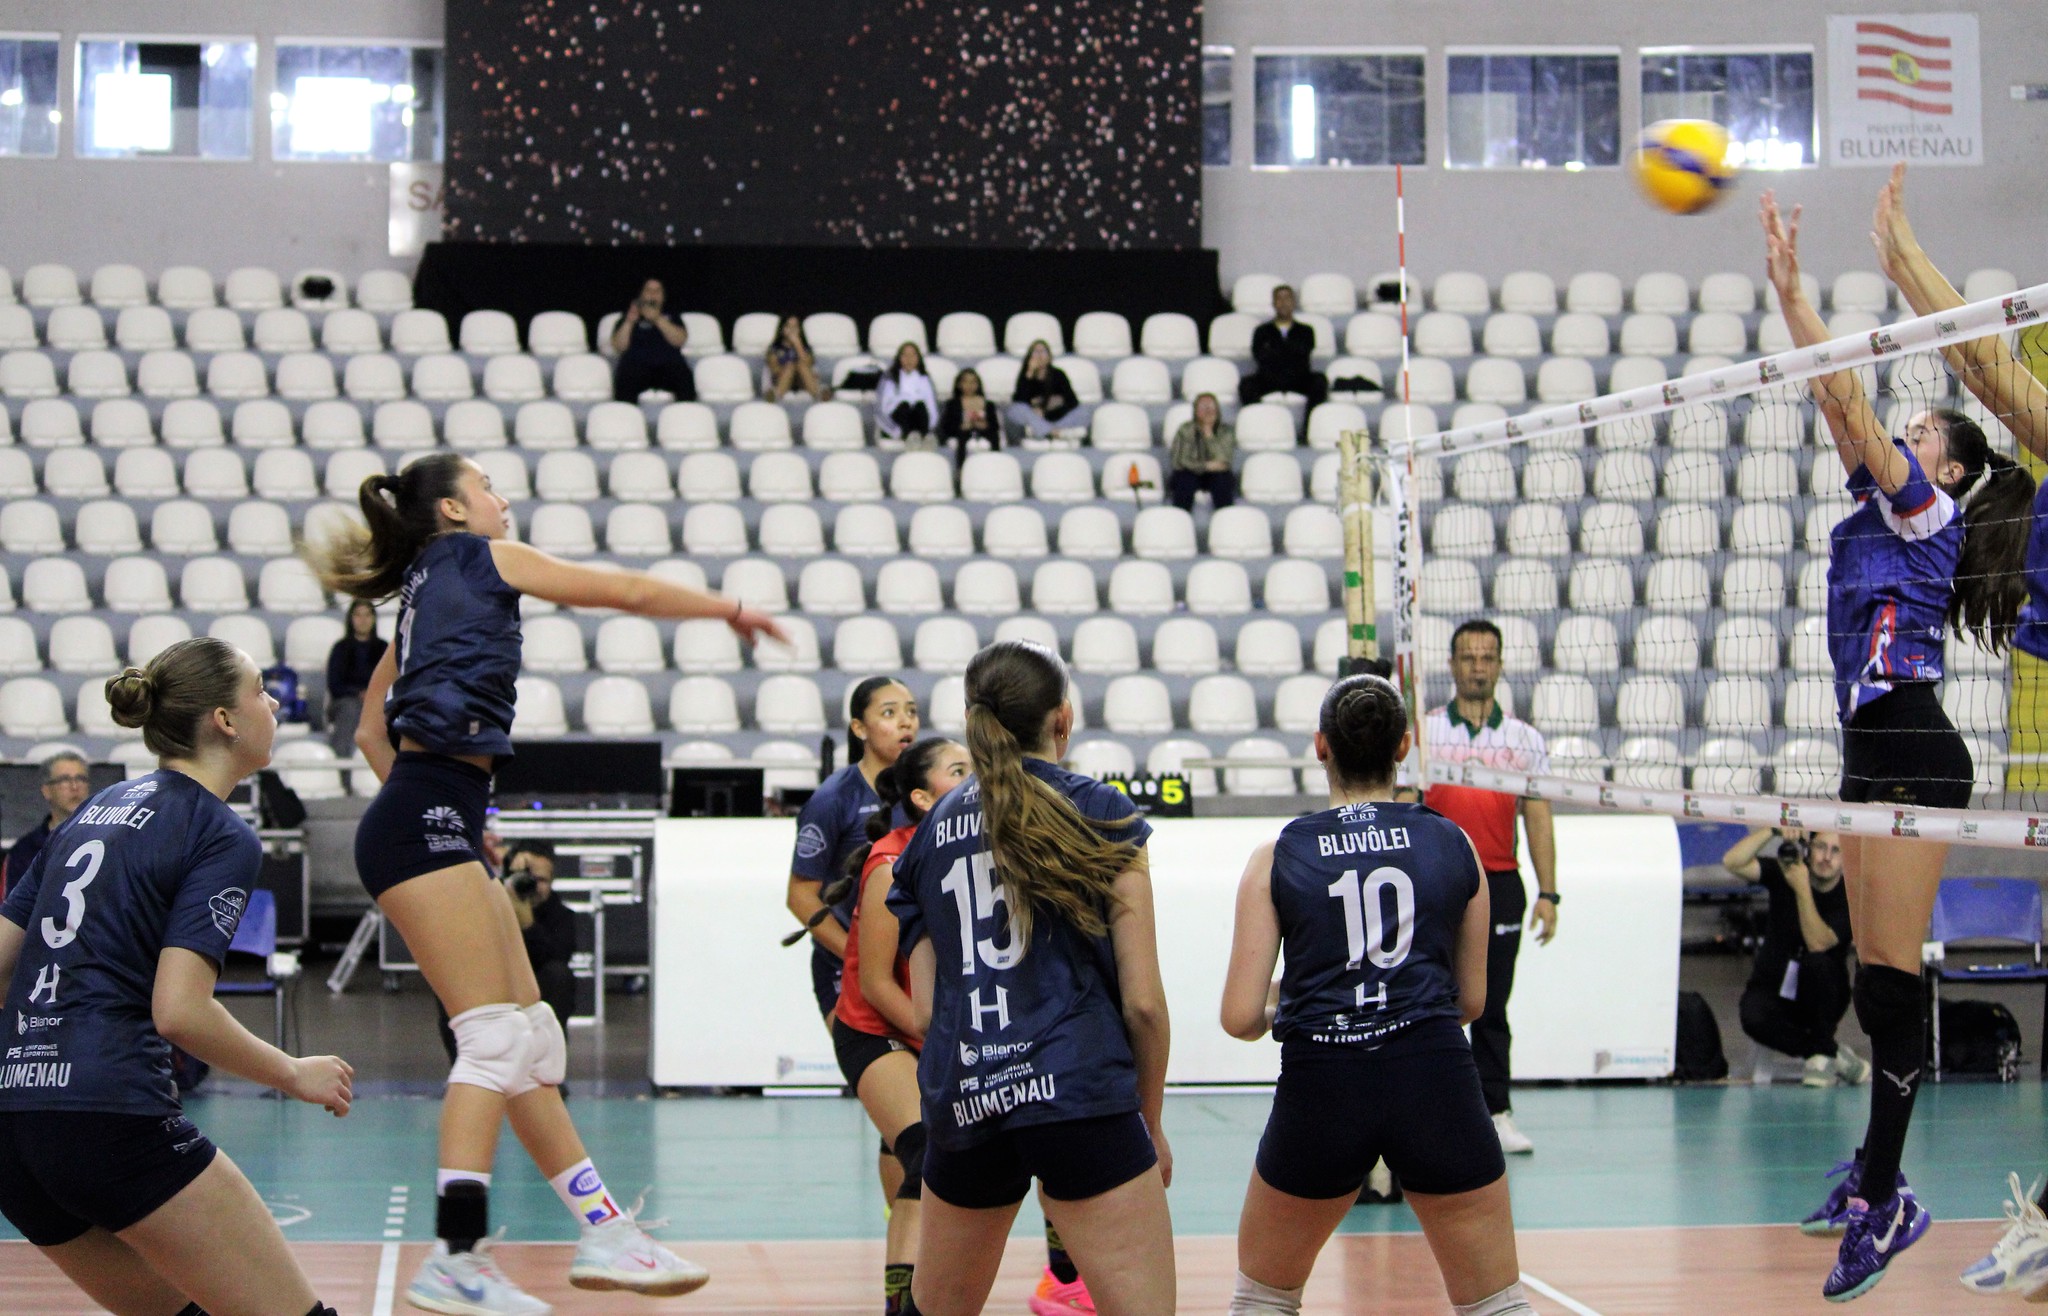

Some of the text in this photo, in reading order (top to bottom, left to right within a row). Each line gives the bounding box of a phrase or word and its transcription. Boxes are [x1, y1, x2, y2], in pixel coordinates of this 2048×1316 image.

[1867, 123, 1944, 135] PREFEITURA
[1839, 136, 1973, 159] BLUMENAU
[1161, 779, 1184, 804] 5
[78, 801, 155, 830] BLUVÔLEI
[936, 811, 983, 849] BLUV
[1342, 811, 1376, 823] FURB
[1318, 825, 1411, 857] BLUVÔLEI
[41, 839, 105, 949] 3
[941, 850, 1032, 976] 15
[1328, 866, 1415, 971] 10
[28, 962, 61, 1004] H
[30, 1016, 63, 1028] Bianor
[967, 984, 1012, 1033] H
[982, 1041, 1033, 1057] Bianor
[0, 1062, 72, 1088] LUMENAU
[952, 1073, 1056, 1127] BLUMENAU
